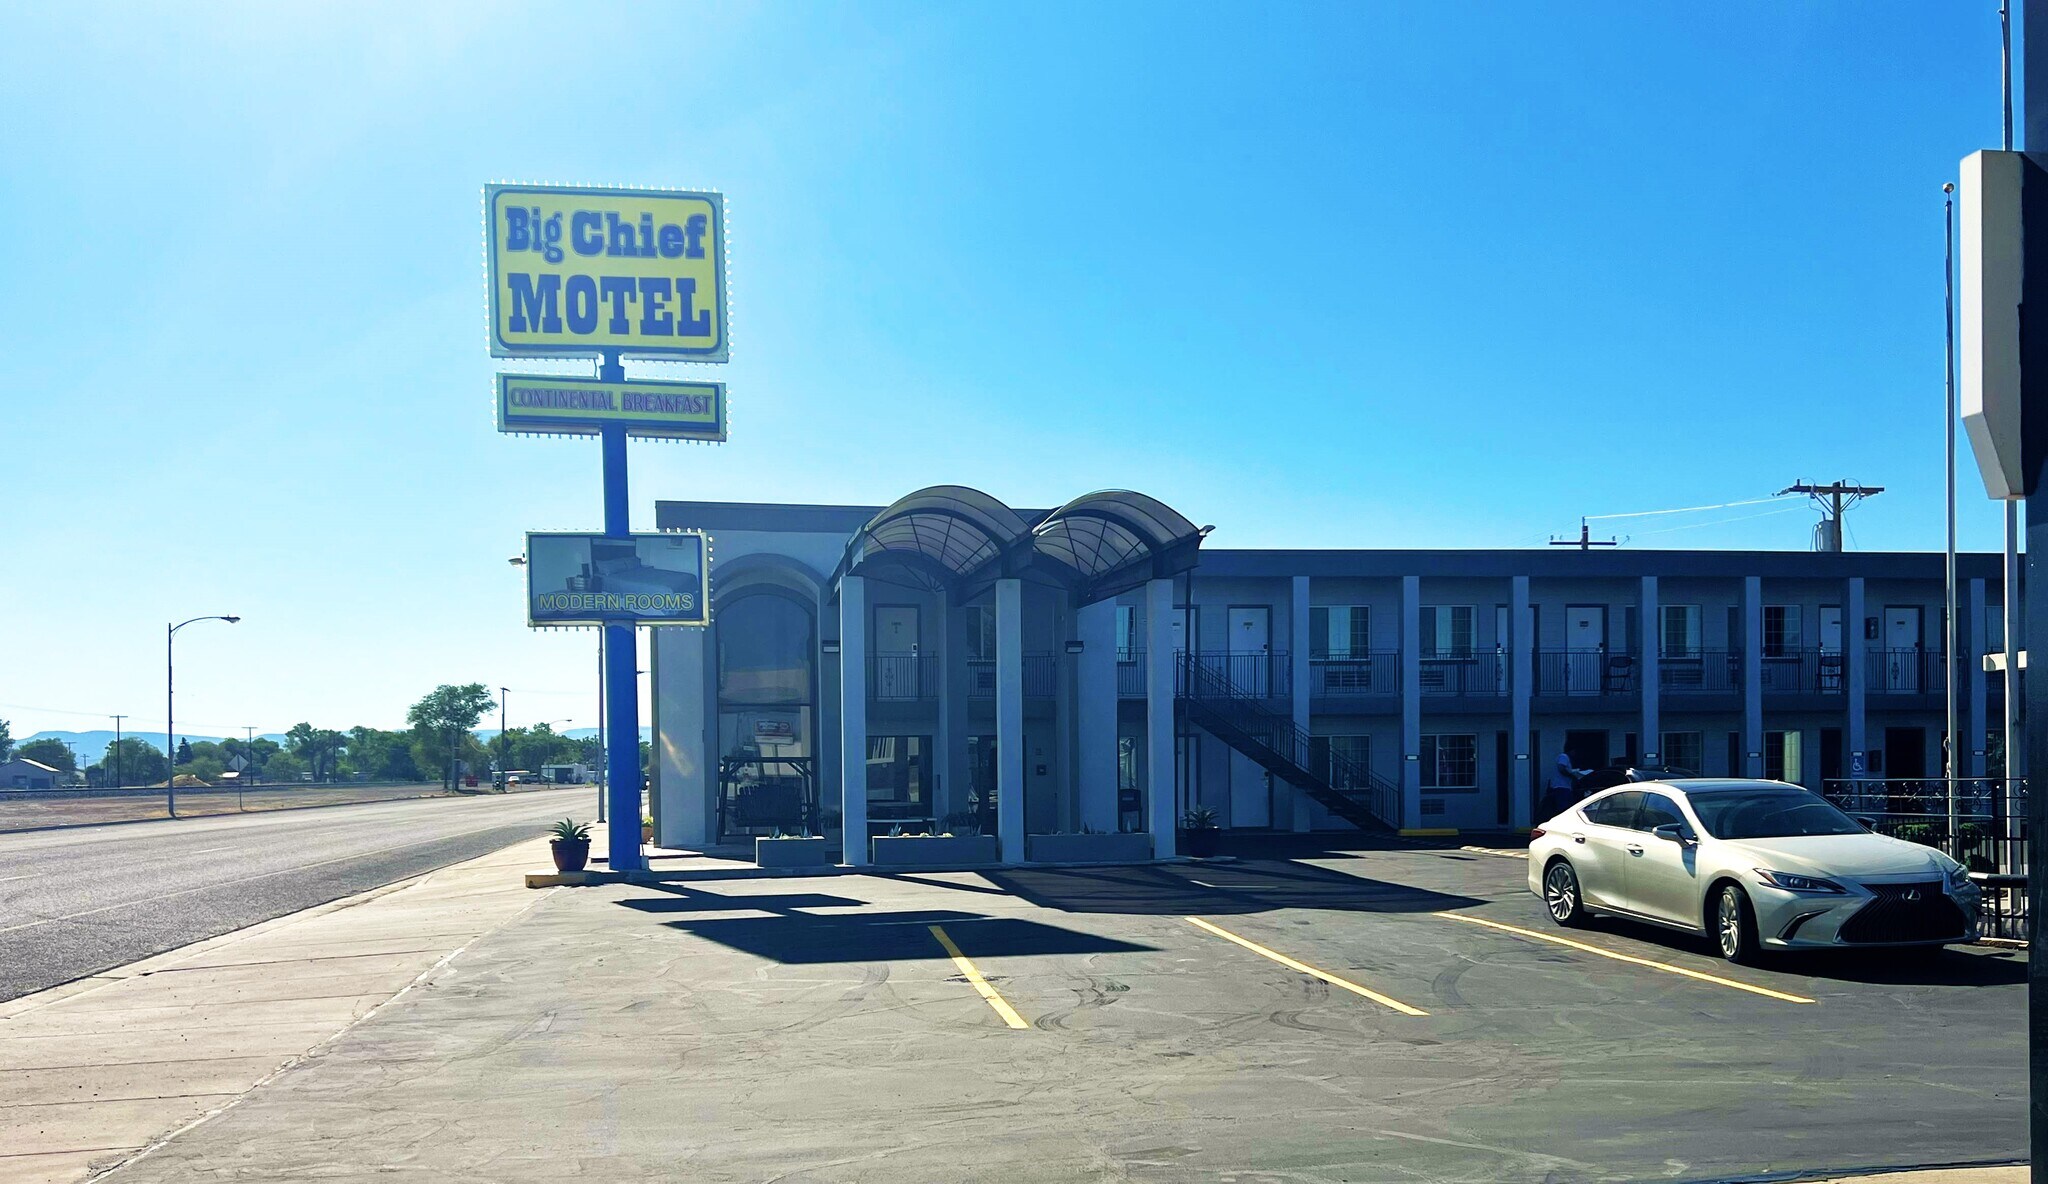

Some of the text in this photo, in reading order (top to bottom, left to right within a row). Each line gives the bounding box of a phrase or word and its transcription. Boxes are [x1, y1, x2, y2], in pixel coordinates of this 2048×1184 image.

[506, 206, 708, 264] Big Chief
[507, 272, 711, 337] MOTEL
[510, 387, 713, 415] CONTINENTAL BREAKFAST
[538, 593, 694, 610] MODERN ROOMS
